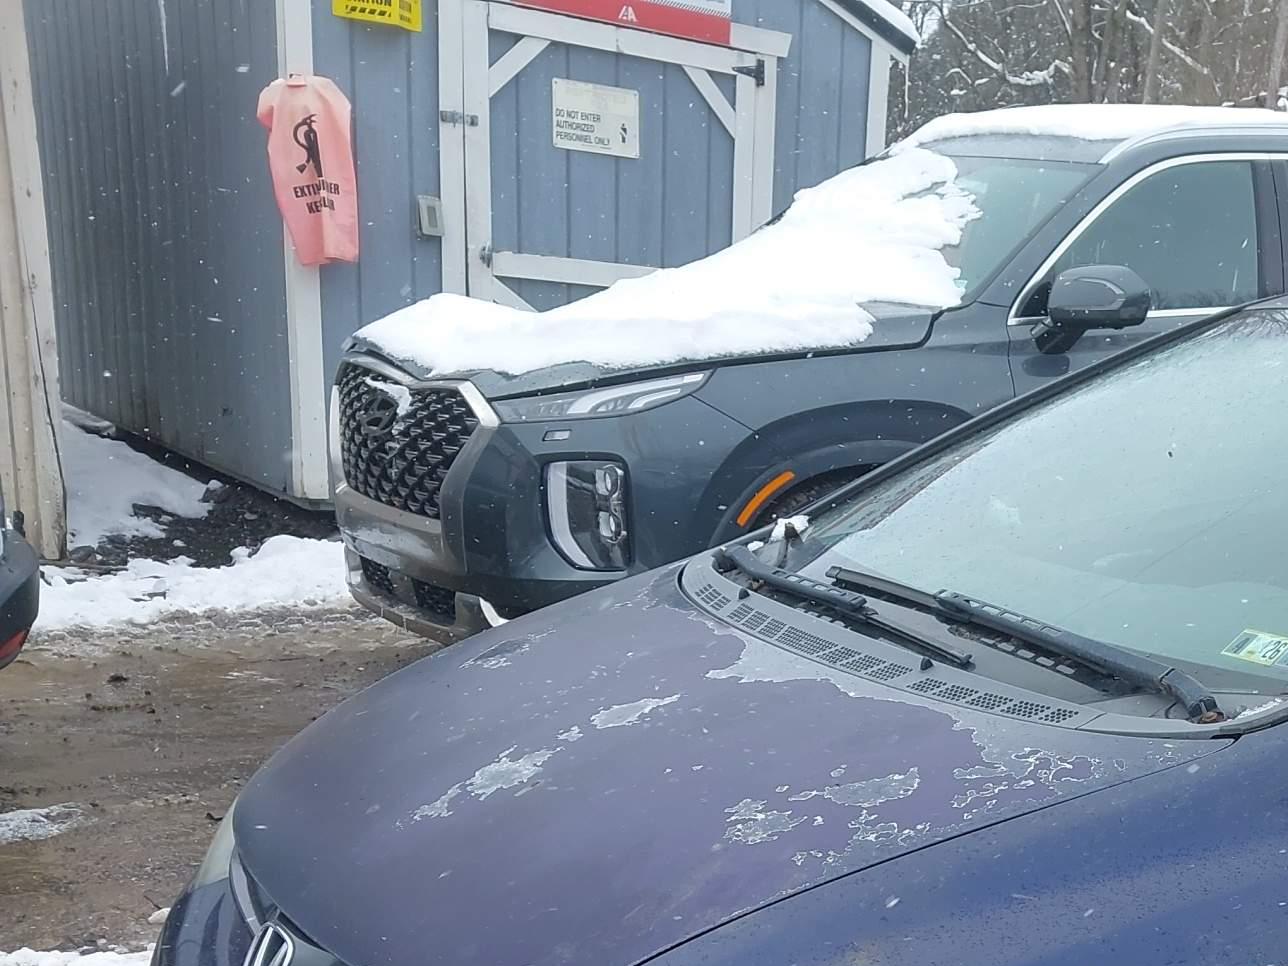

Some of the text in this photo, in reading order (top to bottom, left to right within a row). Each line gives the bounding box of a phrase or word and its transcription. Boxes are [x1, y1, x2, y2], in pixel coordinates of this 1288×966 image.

[555, 108, 601, 122] DO NOT ENTER
[555, 120, 595, 133] AUTHORIZED
[555, 131, 593, 144] PERSONNEL
